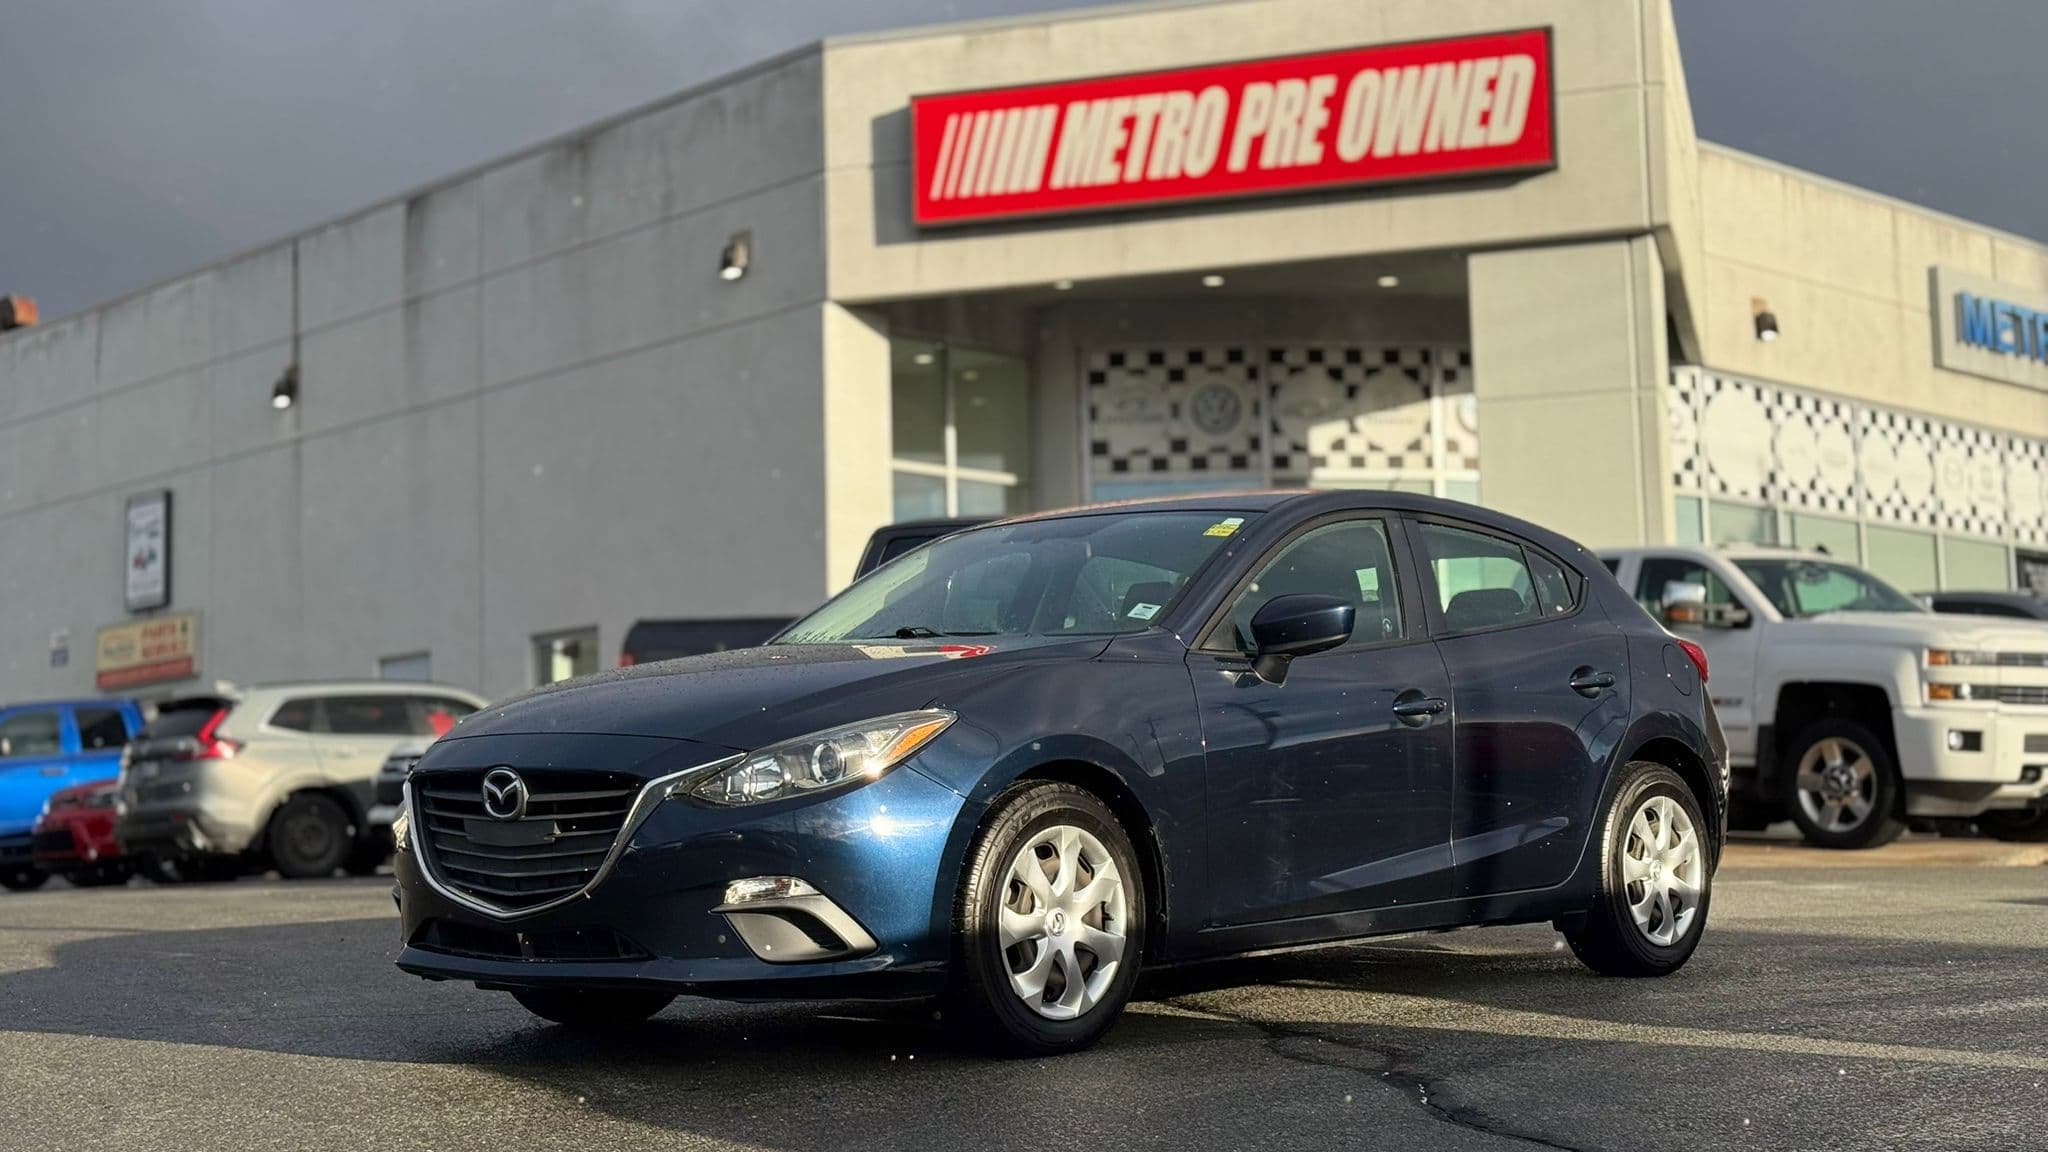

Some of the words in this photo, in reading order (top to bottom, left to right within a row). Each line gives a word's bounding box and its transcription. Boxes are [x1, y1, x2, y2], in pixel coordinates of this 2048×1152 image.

[1049, 86, 1229, 190] METRO
[1227, 74, 1338, 174] PRE
[1335, 53, 1537, 163] OWNED
